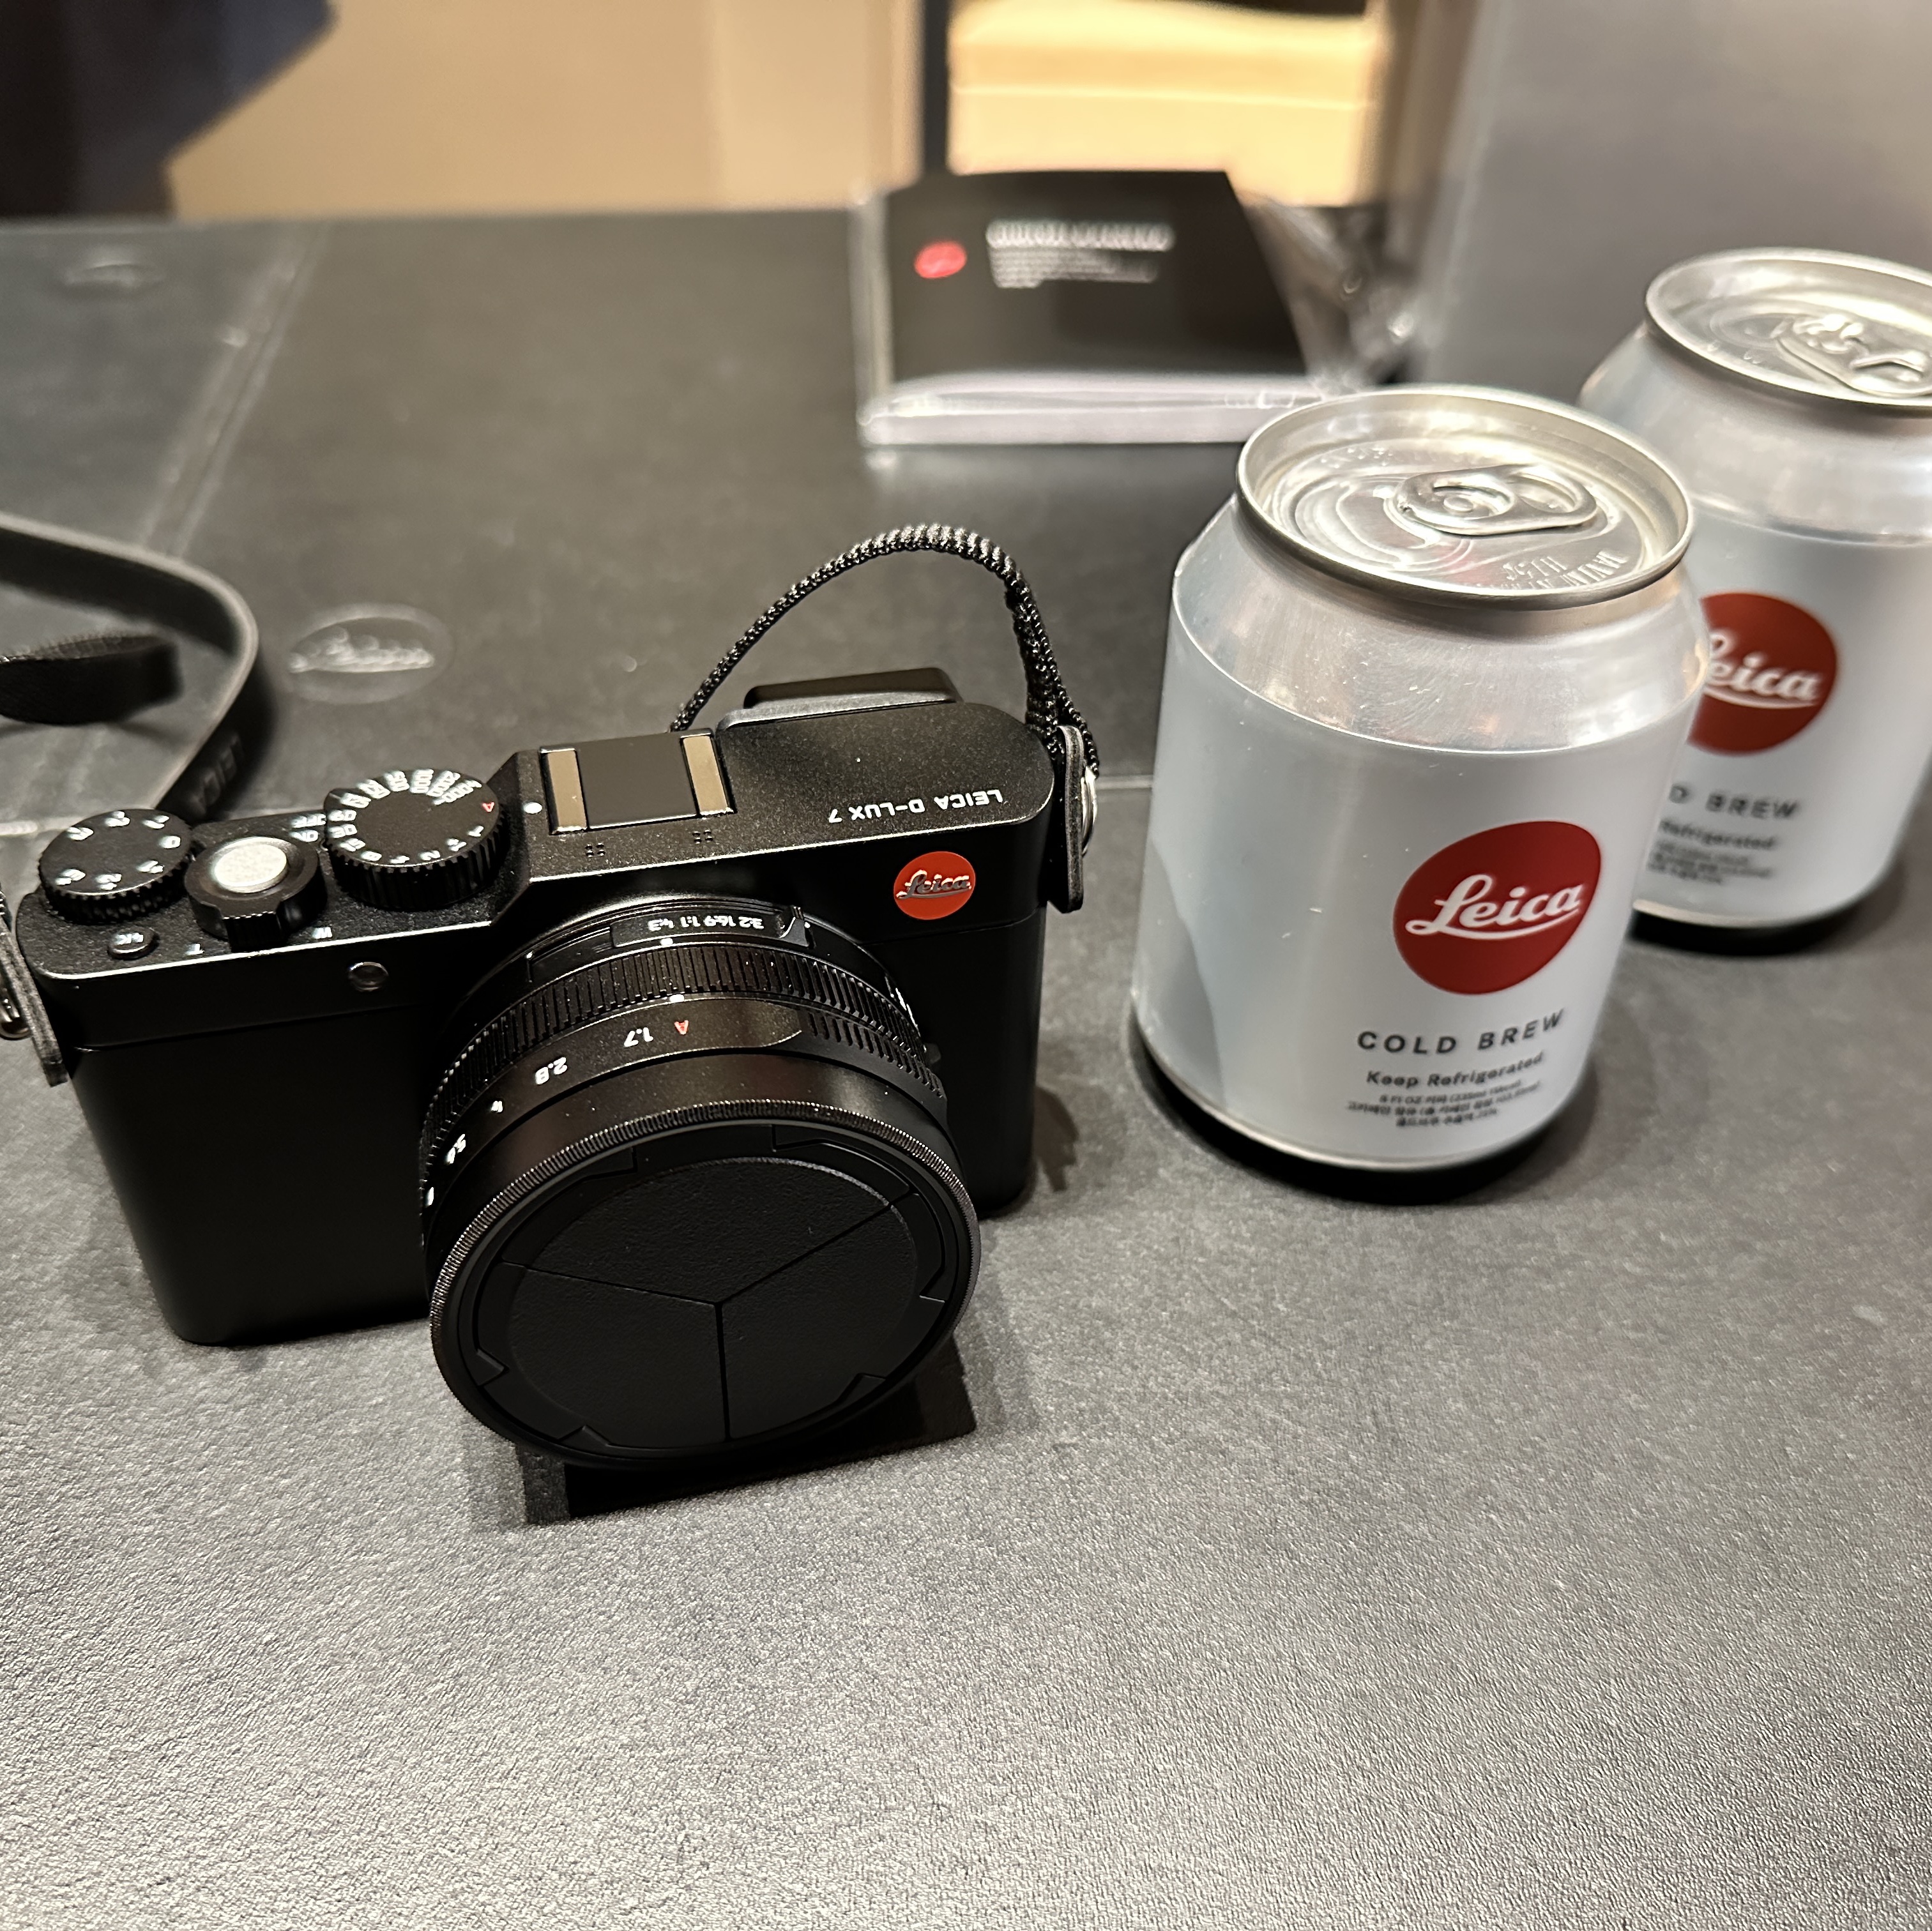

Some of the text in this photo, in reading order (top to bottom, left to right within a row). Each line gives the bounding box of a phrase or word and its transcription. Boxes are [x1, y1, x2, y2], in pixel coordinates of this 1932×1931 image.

[411, 769, 434, 793] 1000
[427, 771, 460, 797] 2000
[328, 810, 357, 822] 60
[481, 802, 495, 812] A
[828, 789, 1003, 824] LEICA D-LUX 7
[289, 829, 319, 842] ON
[895, 869, 972, 899] Leica
[1405, 874, 1583, 941] Leica
[312, 927, 333, 939] W
[647, 915, 764, 932] 3:2 16:9 1:1 4:3
[623, 1027, 654, 1047] 1.7
[674, 1019, 689, 1035] A
[1357, 1007, 1564, 1054] COLD BREW
[535, 1057, 568, 1085] 2.8
[1365, 1050, 1544, 1089] Keep Refrigerated
